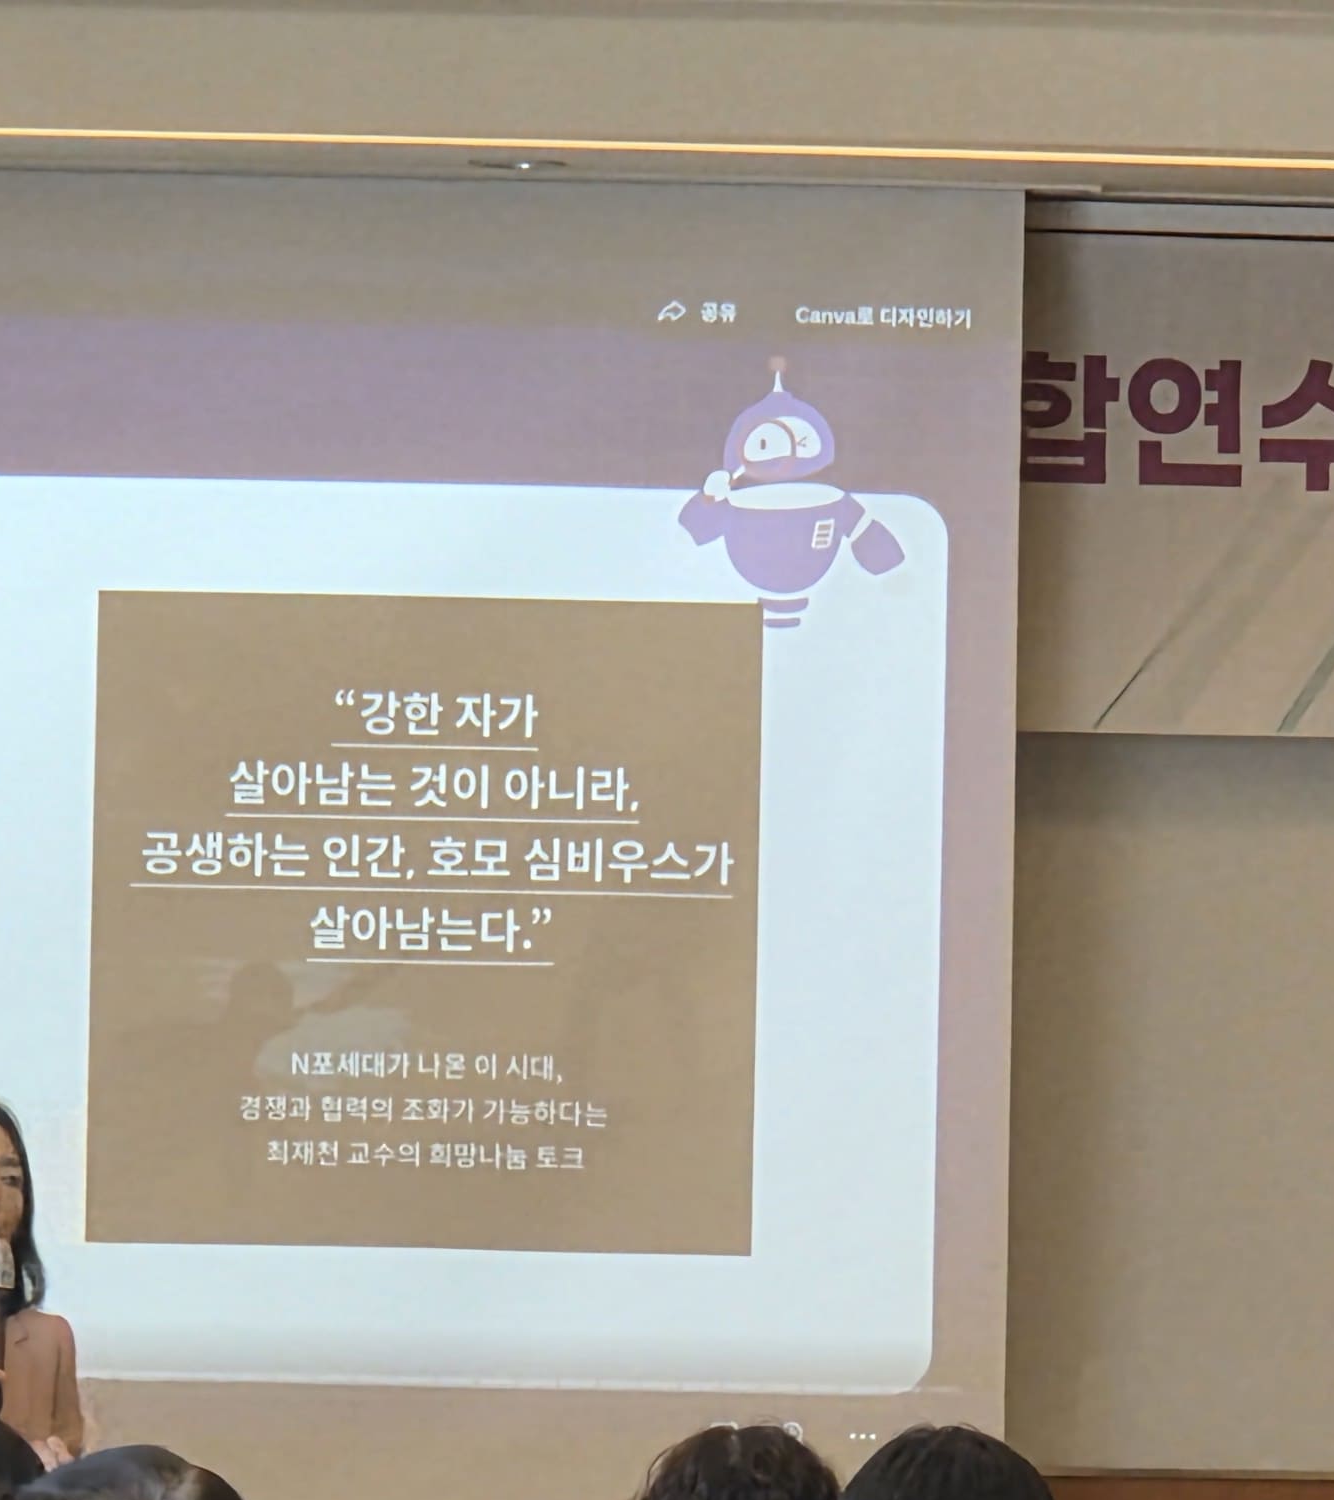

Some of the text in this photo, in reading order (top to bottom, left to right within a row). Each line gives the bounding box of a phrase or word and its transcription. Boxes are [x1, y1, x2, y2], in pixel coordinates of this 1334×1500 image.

[700, 301, 737, 324] 공유
[794, 306, 972, 329] Canva로 디자인하기
[455, 692, 539, 739] 자가
[229, 759, 639, 813] 살아남는 것이 아니라,
[141, 831, 735, 886] 공생하는 인간, 호모 심비우스가
[417, 1052, 466, 1080] 나온
[474, 1052, 497, 1081] 이
[505, 1053, 563, 1085] 시대,
[239, 1095, 312, 1122] 경쟁과
[401, 1097, 475, 1125] 조화가
[482, 1098, 608, 1128] 가능하다는
[266, 1139, 339, 1167] 최재천
[346, 1141, 421, 1168] 교수의
[535, 1145, 585, 1169] 토크
